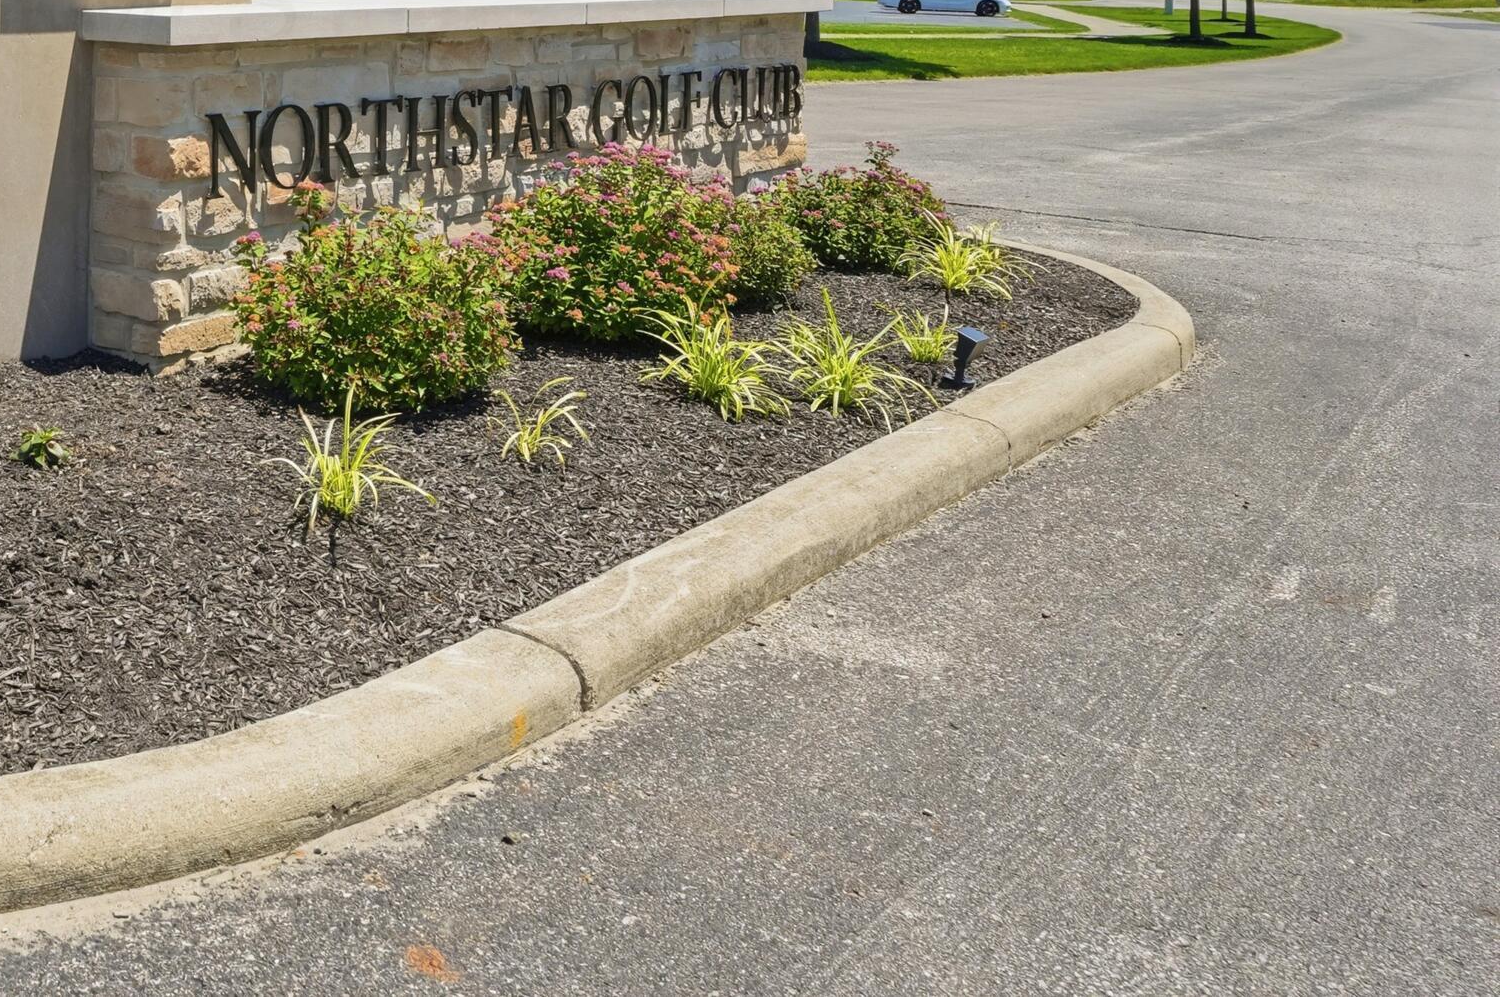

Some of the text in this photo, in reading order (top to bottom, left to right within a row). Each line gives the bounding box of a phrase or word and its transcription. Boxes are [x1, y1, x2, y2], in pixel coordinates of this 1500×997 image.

[205, 63, 803, 199] NORTHSTAR GOLF CLUB
